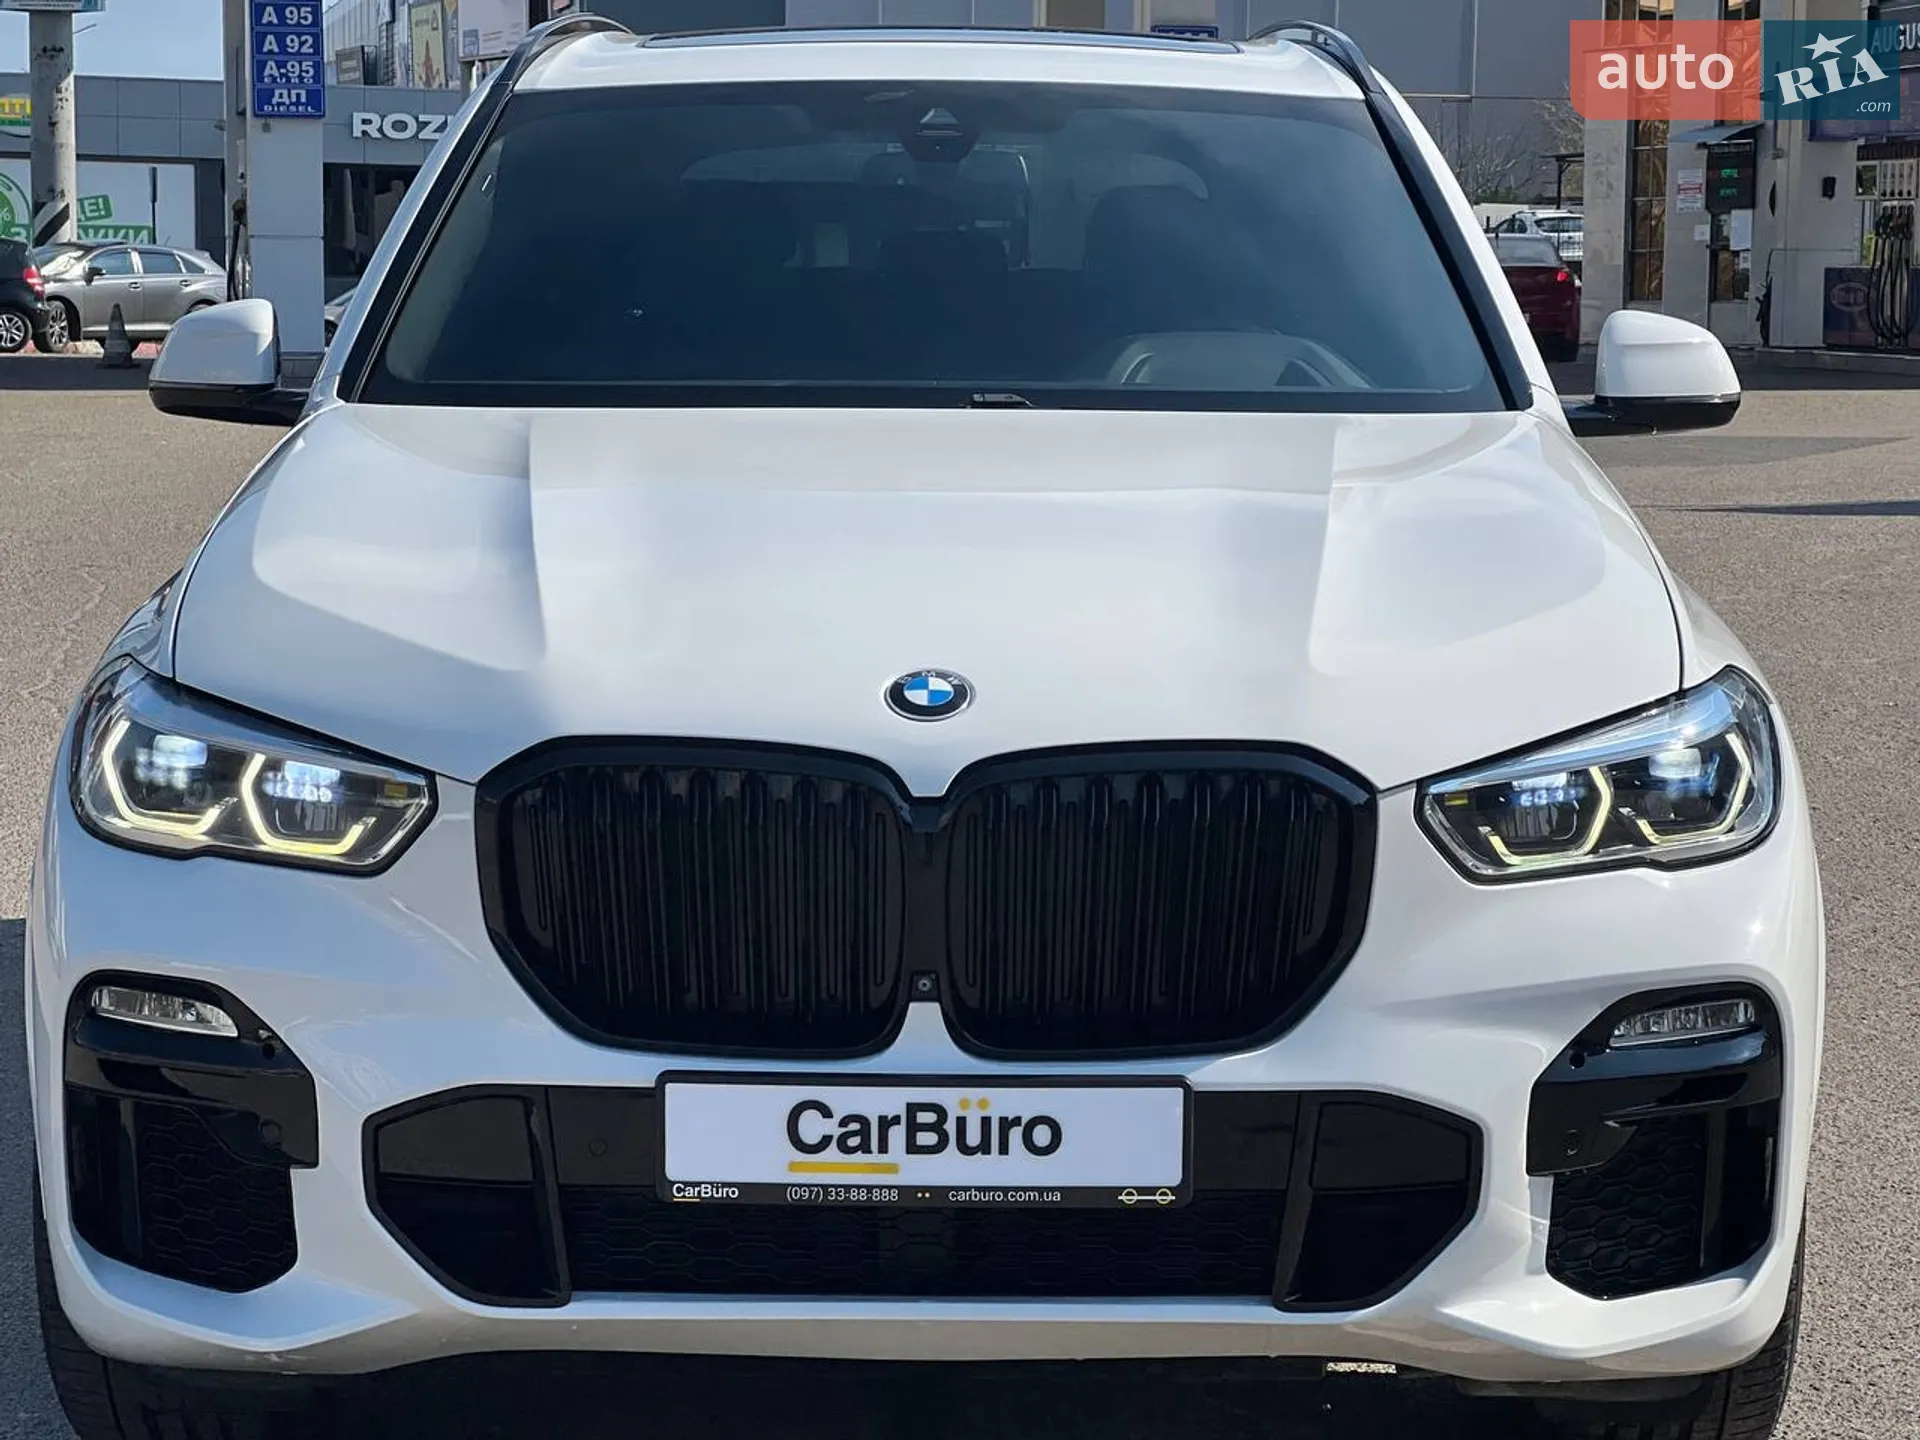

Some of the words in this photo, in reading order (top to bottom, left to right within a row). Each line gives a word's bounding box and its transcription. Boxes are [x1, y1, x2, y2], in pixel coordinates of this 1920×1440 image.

[284, 6, 314, 26] 95
[285, 34, 314, 54] 92
[263, 60, 315, 78] A-95
[271, 89, 307, 105] ДП
[263, 104, 317, 113] DIESEL
[352, 111, 456, 140] ROZ
[786, 1096, 1063, 1157] CarBüro
[672, 1182, 740, 1199] CarBüro
[785, 1187, 825, 1202] (097)
[826, 1187, 900, 1202] 33-88-888
[947, 1187, 1062, 1202] carburo.com.ua
